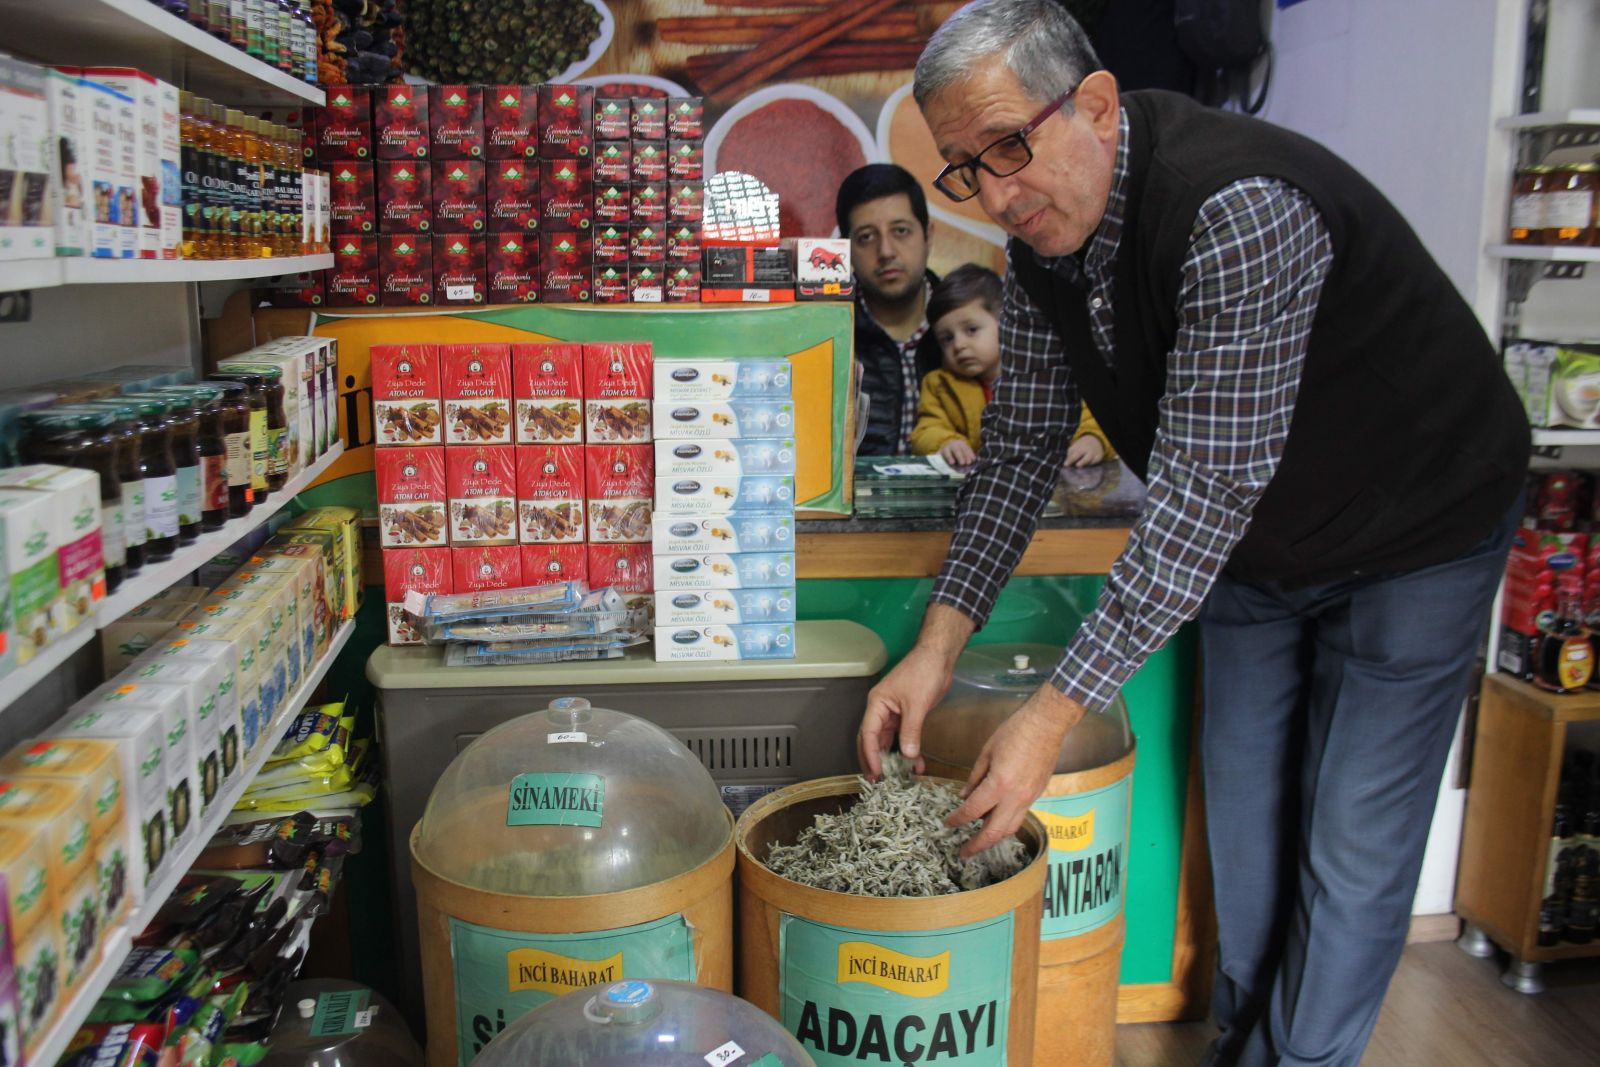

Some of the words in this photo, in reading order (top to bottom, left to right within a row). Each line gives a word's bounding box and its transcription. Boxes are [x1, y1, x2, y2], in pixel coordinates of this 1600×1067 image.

[512, 782, 599, 812] SİNAMEKİ
[519, 962, 547, 984] İNCİ
[550, 965, 615, 988] BAHARAT
[849, 955, 877, 976] İNCİ
[880, 961, 942, 984] BAHARAT
[796, 1000, 998, 1067] ADAÇAYI
